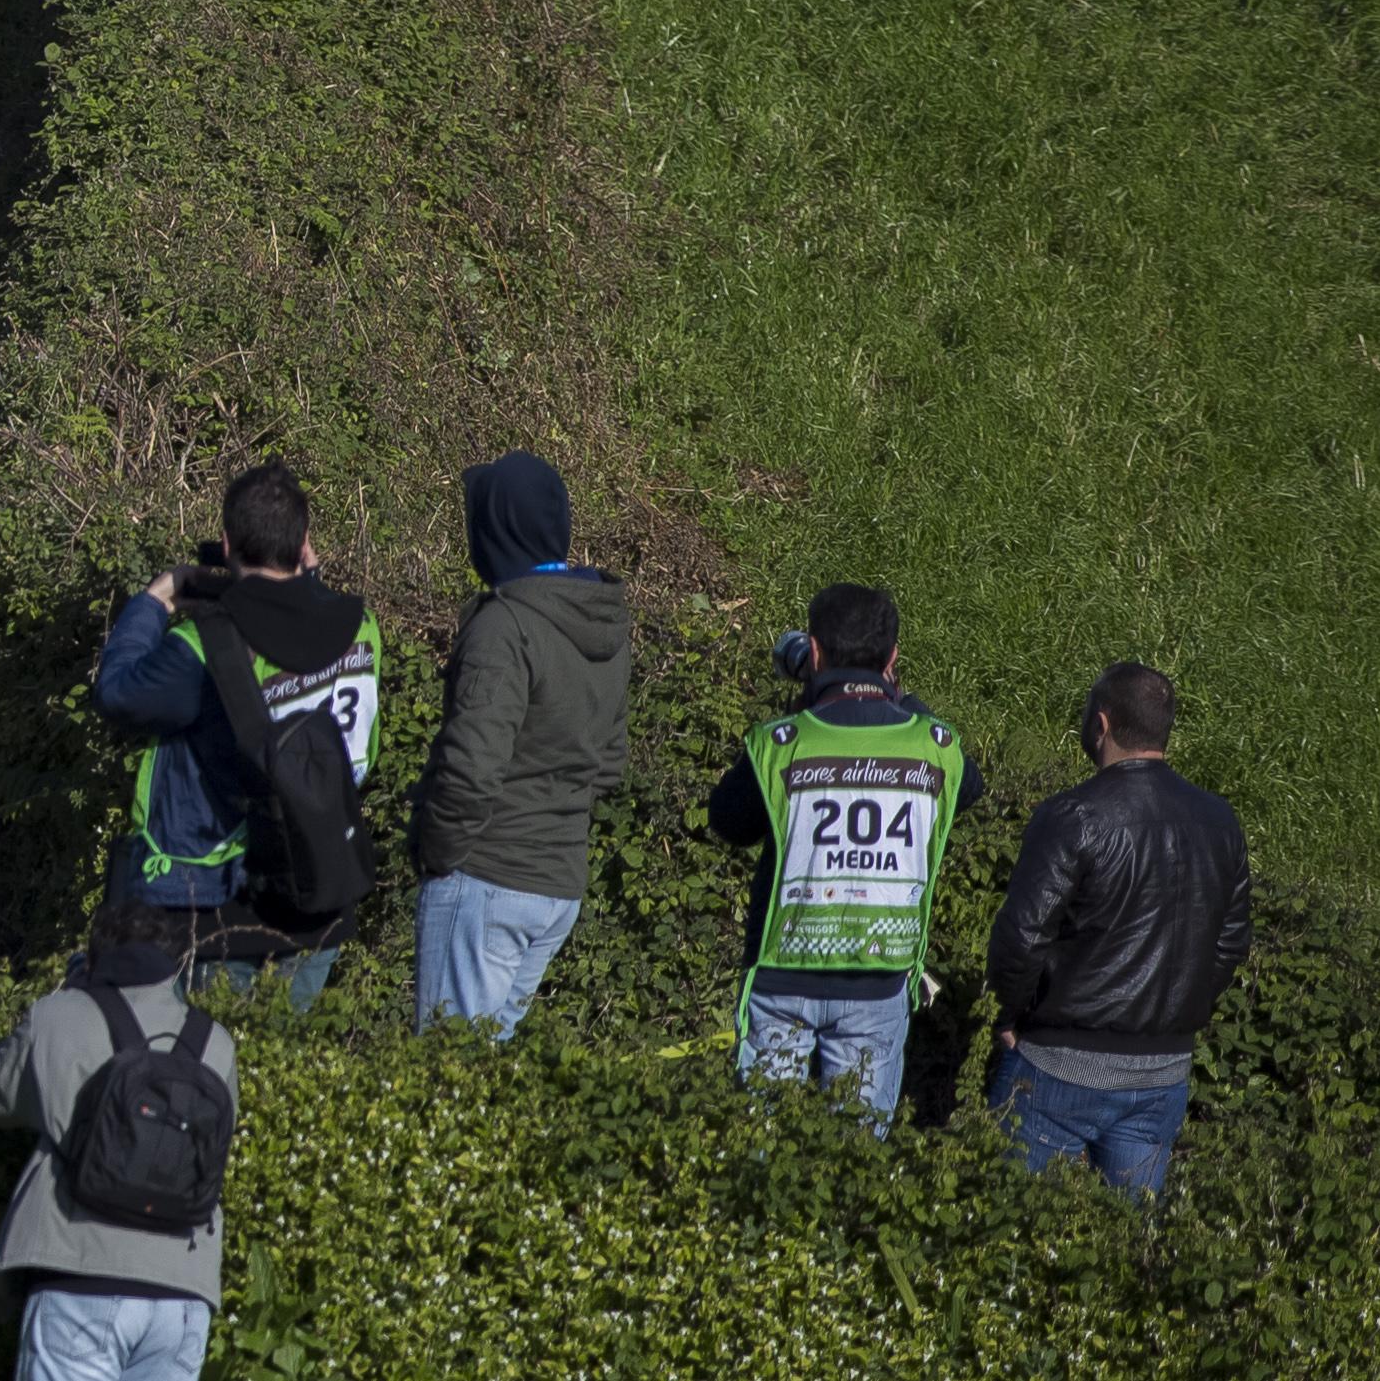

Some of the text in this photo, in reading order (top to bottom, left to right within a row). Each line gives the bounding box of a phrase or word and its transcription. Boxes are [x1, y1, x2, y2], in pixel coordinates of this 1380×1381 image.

[262, 676, 300, 704] zores
[791, 766, 836, 785] zores
[842, 757, 900, 785] airlines
[812, 798, 914, 847] 204
[826, 850, 899, 872] MEDIA
